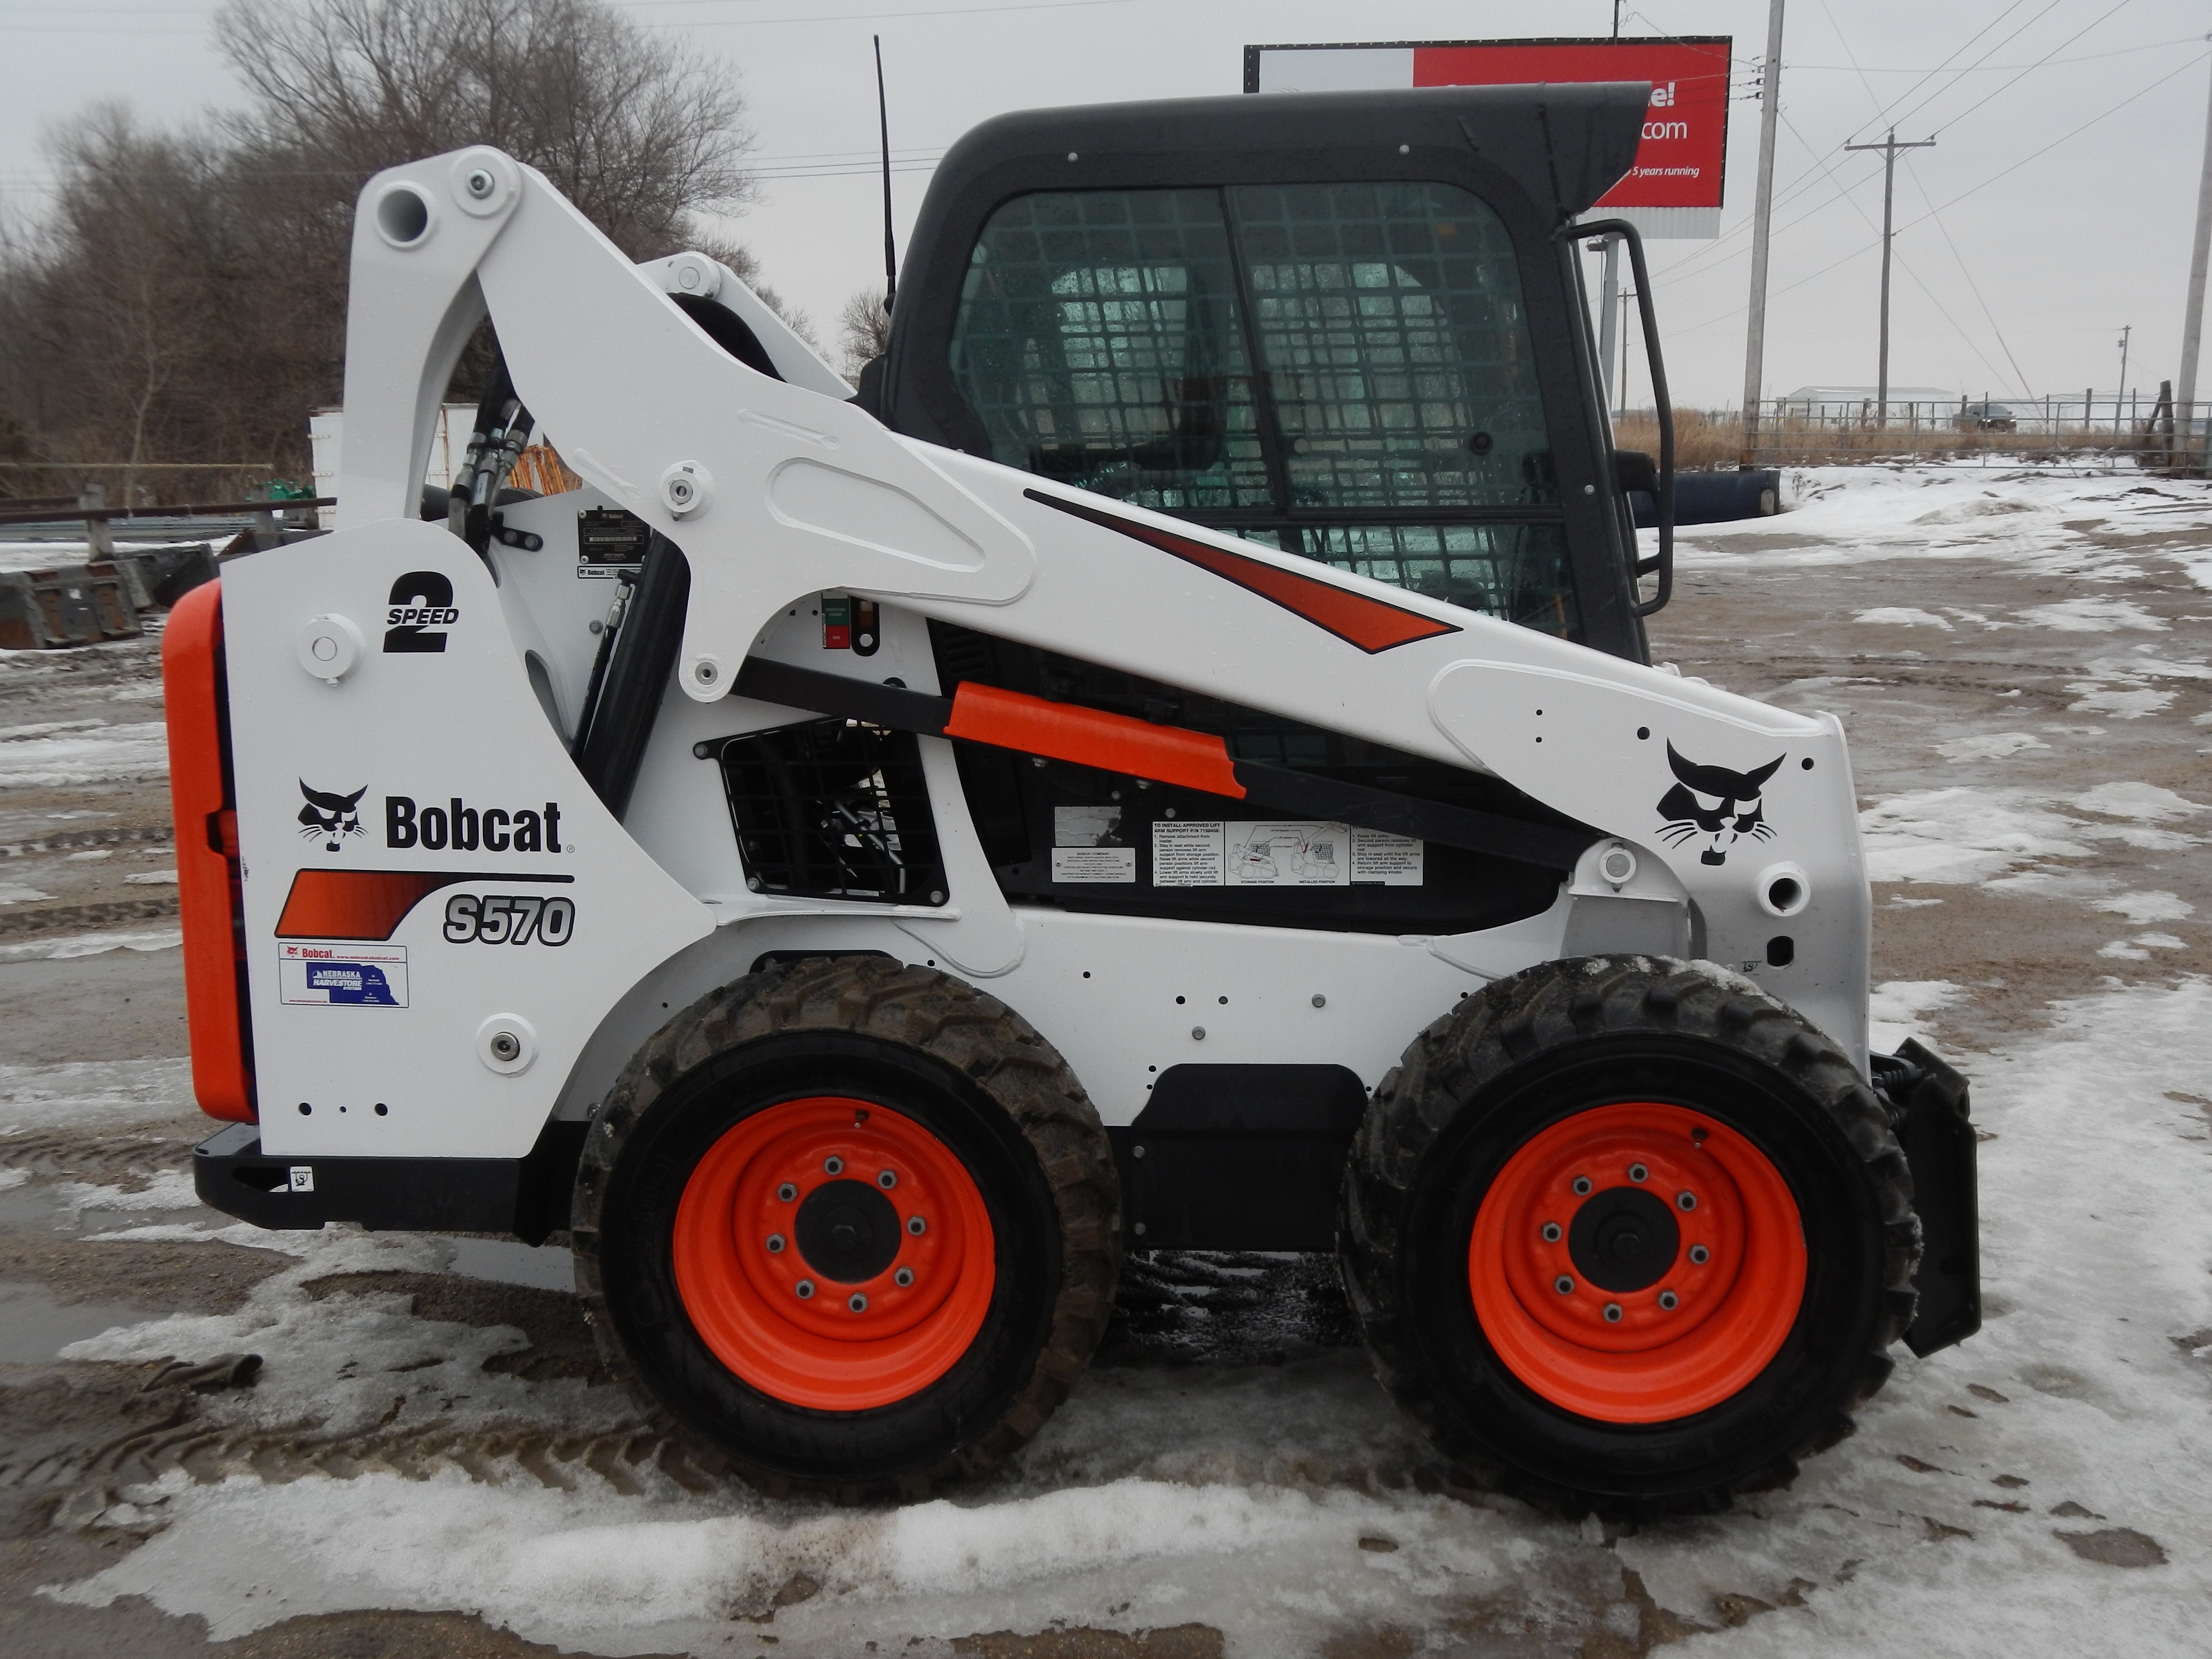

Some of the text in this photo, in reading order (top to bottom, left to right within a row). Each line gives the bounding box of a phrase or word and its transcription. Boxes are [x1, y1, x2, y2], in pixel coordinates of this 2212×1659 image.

[1648, 82, 1675, 107] e!
[1639, 168, 1663, 177] years
[1664, 166, 1700, 177] running
[383, 571, 453, 652] 2
[387, 609, 459, 625] SPEED
[385, 796, 561, 853] Bobcat
[443, 894, 576, 946] S570
[302, 948, 333, 958] Bobcat
